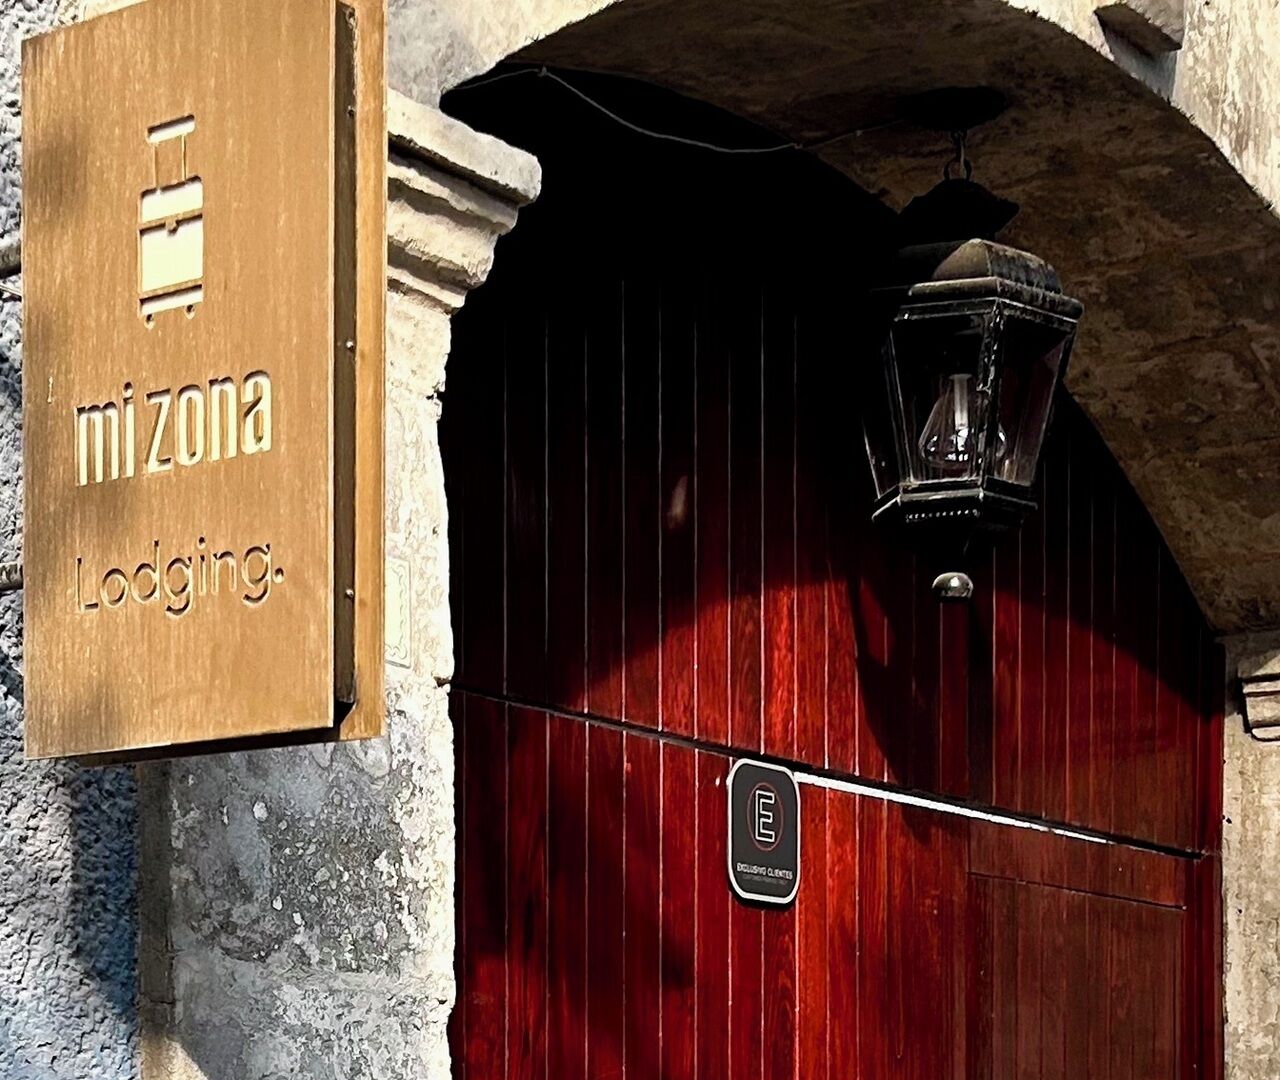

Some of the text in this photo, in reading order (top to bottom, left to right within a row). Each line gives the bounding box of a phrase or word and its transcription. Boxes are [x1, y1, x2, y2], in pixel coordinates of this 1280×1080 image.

[75, 536, 284, 619] Lodging.
[755, 790, 775, 842] E
[767, 867, 793, 880] CLIENTES
